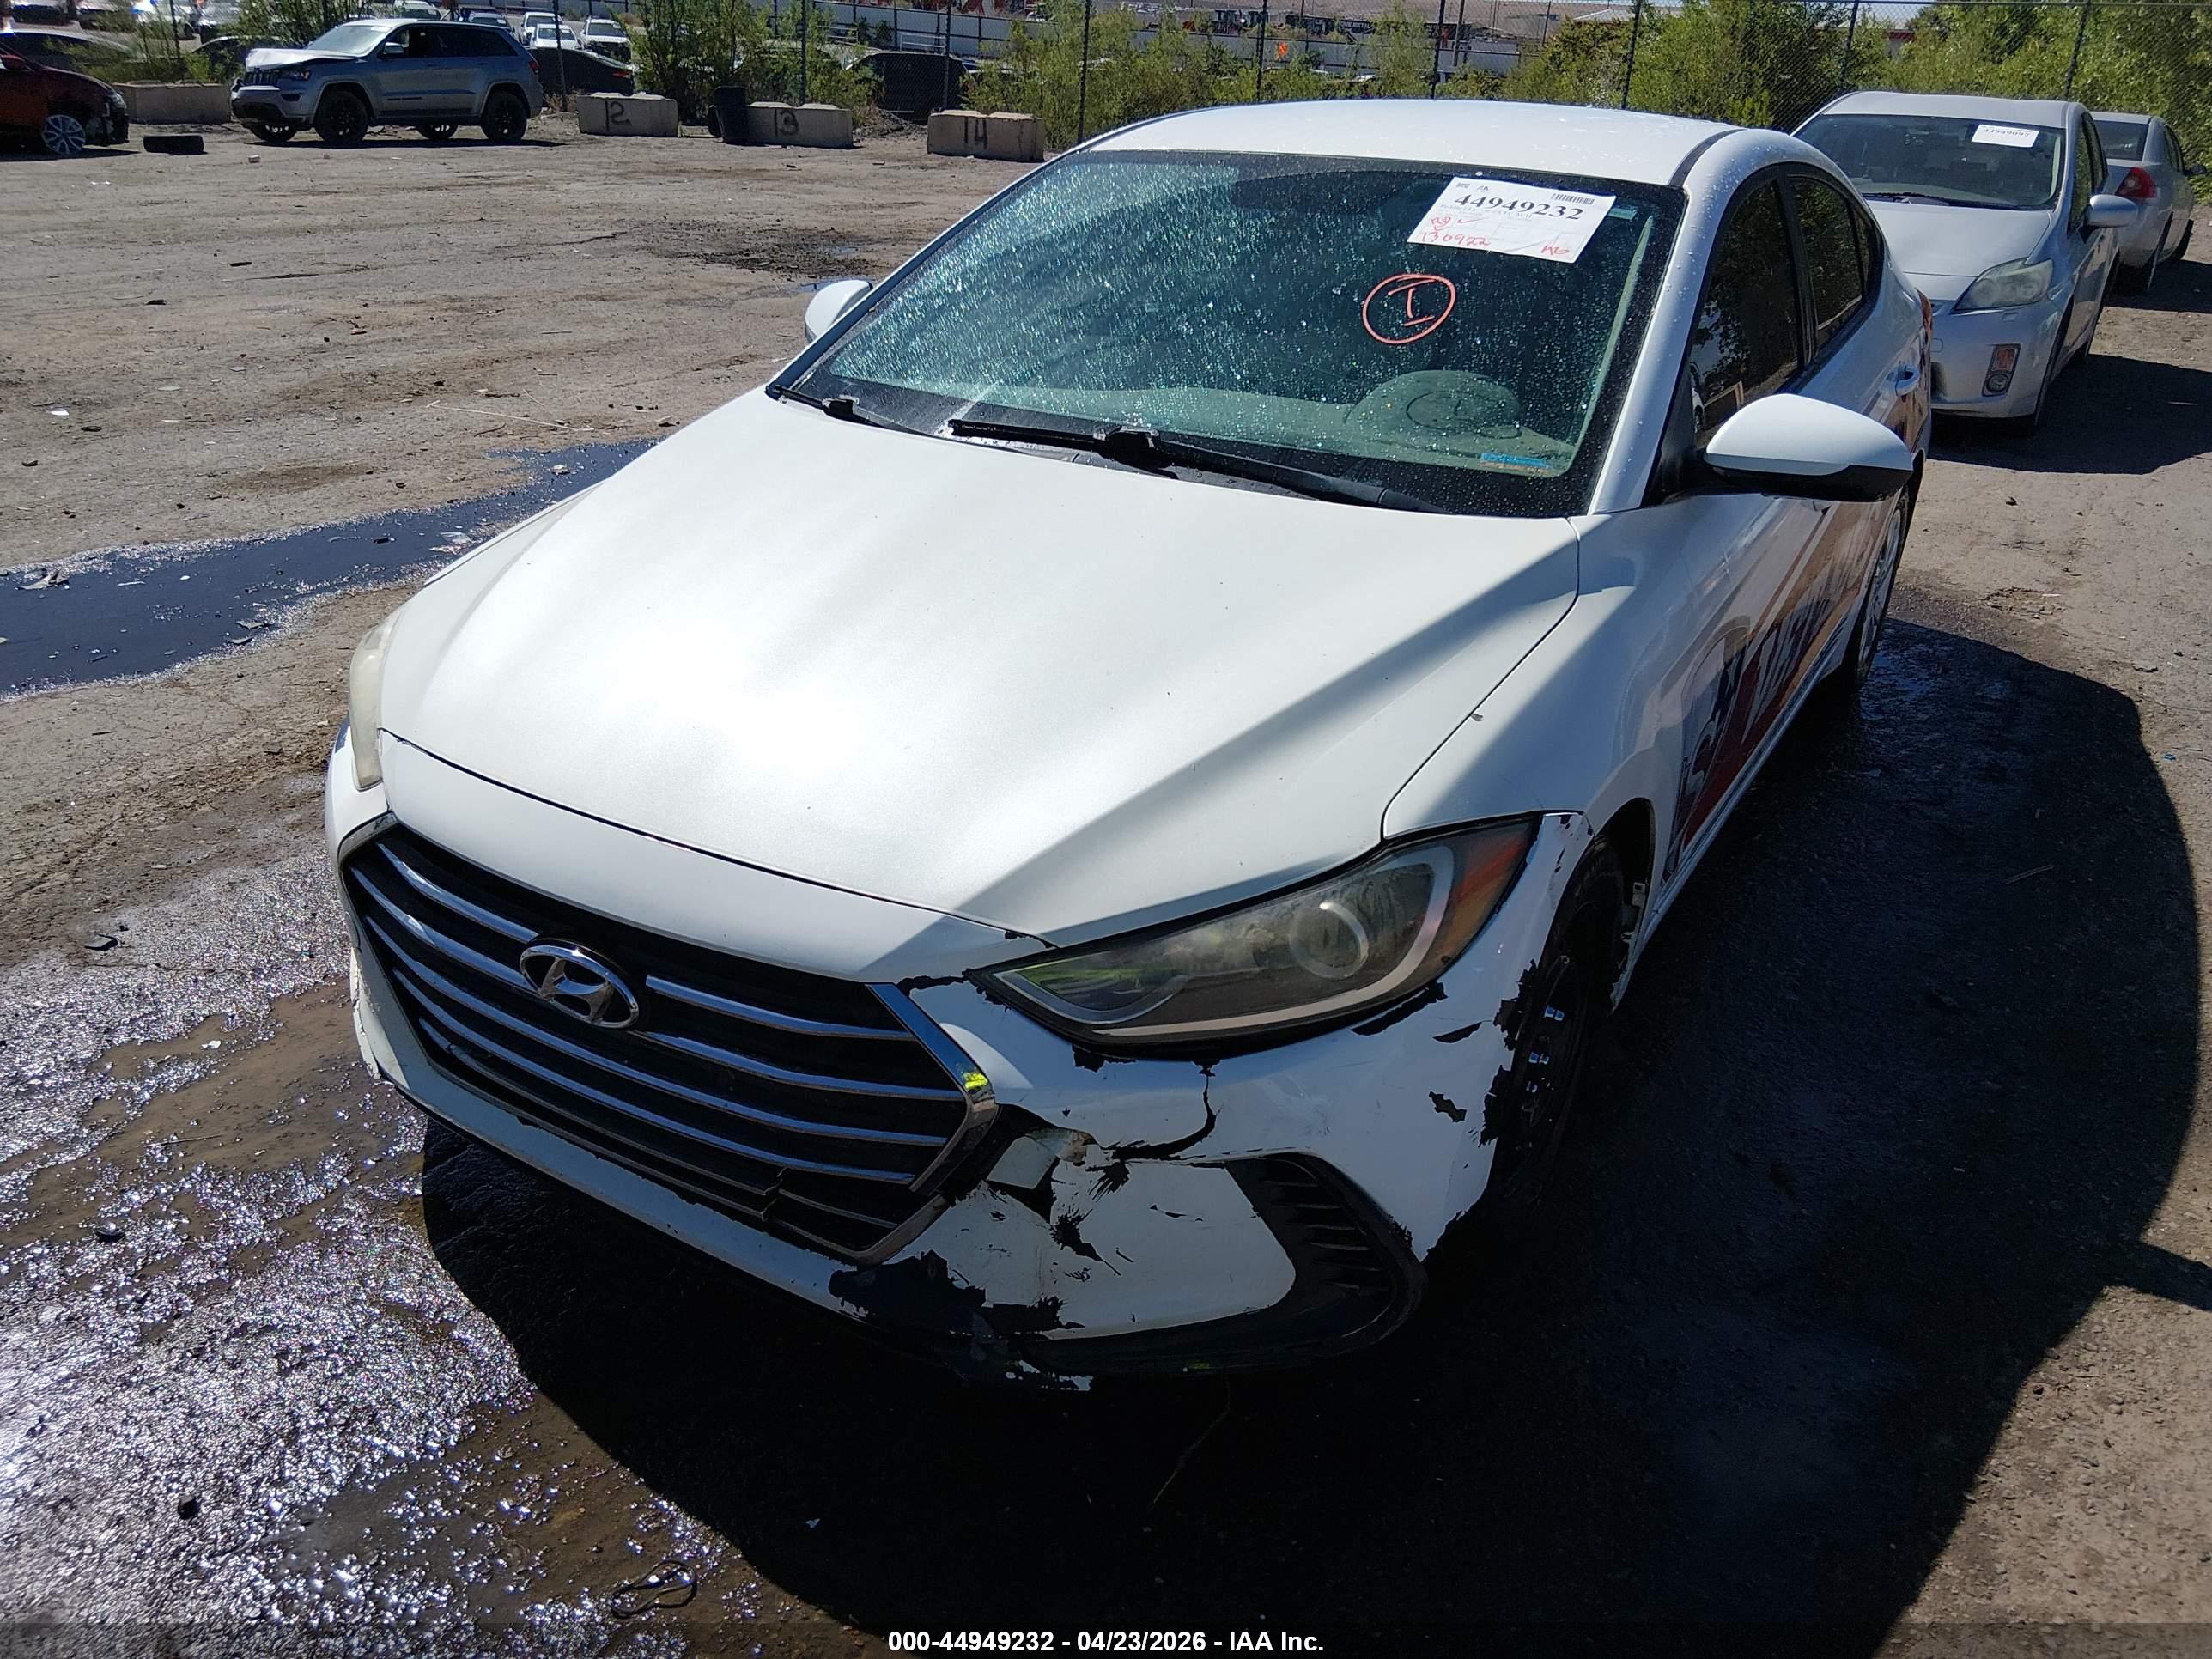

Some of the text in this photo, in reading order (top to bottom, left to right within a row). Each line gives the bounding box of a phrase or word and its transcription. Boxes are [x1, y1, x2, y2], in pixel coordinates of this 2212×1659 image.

[605, 98, 631, 129] 12
[775, 109, 799, 137] 13
[964, 117, 988, 149] 14
[1454, 194, 1583, 220] 44949232
